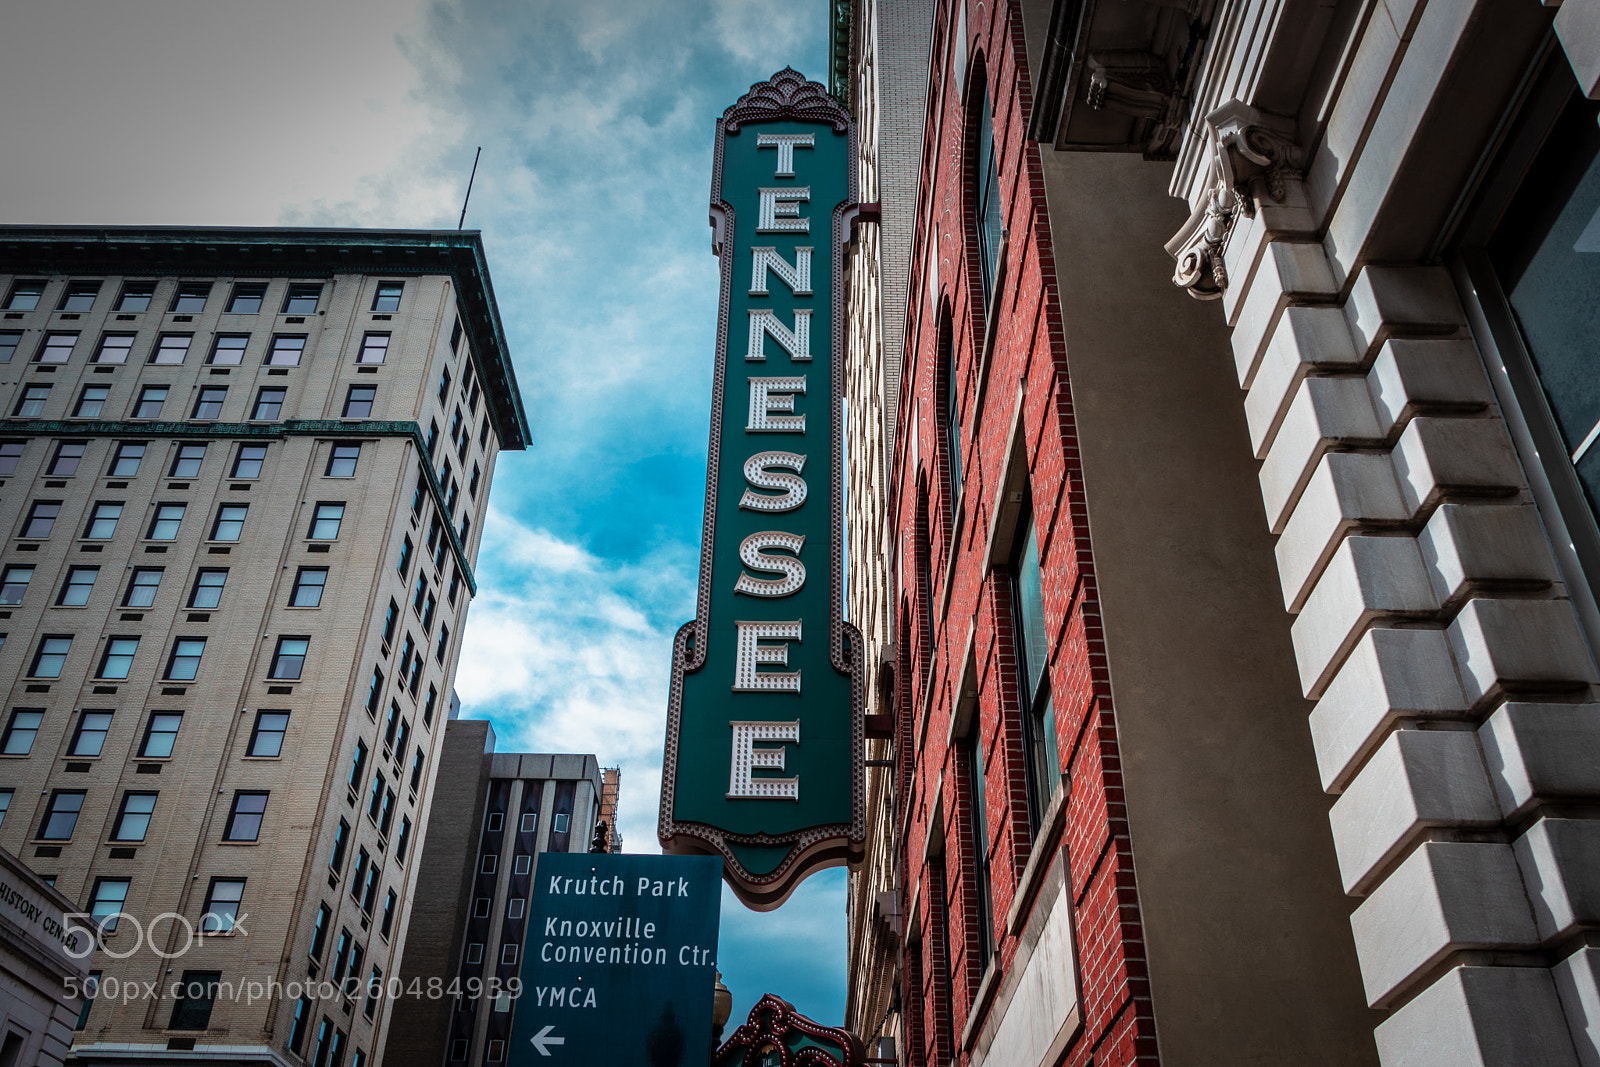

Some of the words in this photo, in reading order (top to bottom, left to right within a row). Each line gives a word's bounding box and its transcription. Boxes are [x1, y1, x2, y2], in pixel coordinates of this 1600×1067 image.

[727, 132, 815, 801] TENNESSEE
[549, 875, 625, 895] Krutch
[637, 876, 689, 897] Park
[0, 882, 42, 923] HISTORY
[43, 916, 78, 951] CENTER
[544, 917, 656, 938] Knoxville
[541, 942, 667, 964] Convention
[678, 945, 715, 966] Ctr.
[535, 986, 597, 1008] YMCA
